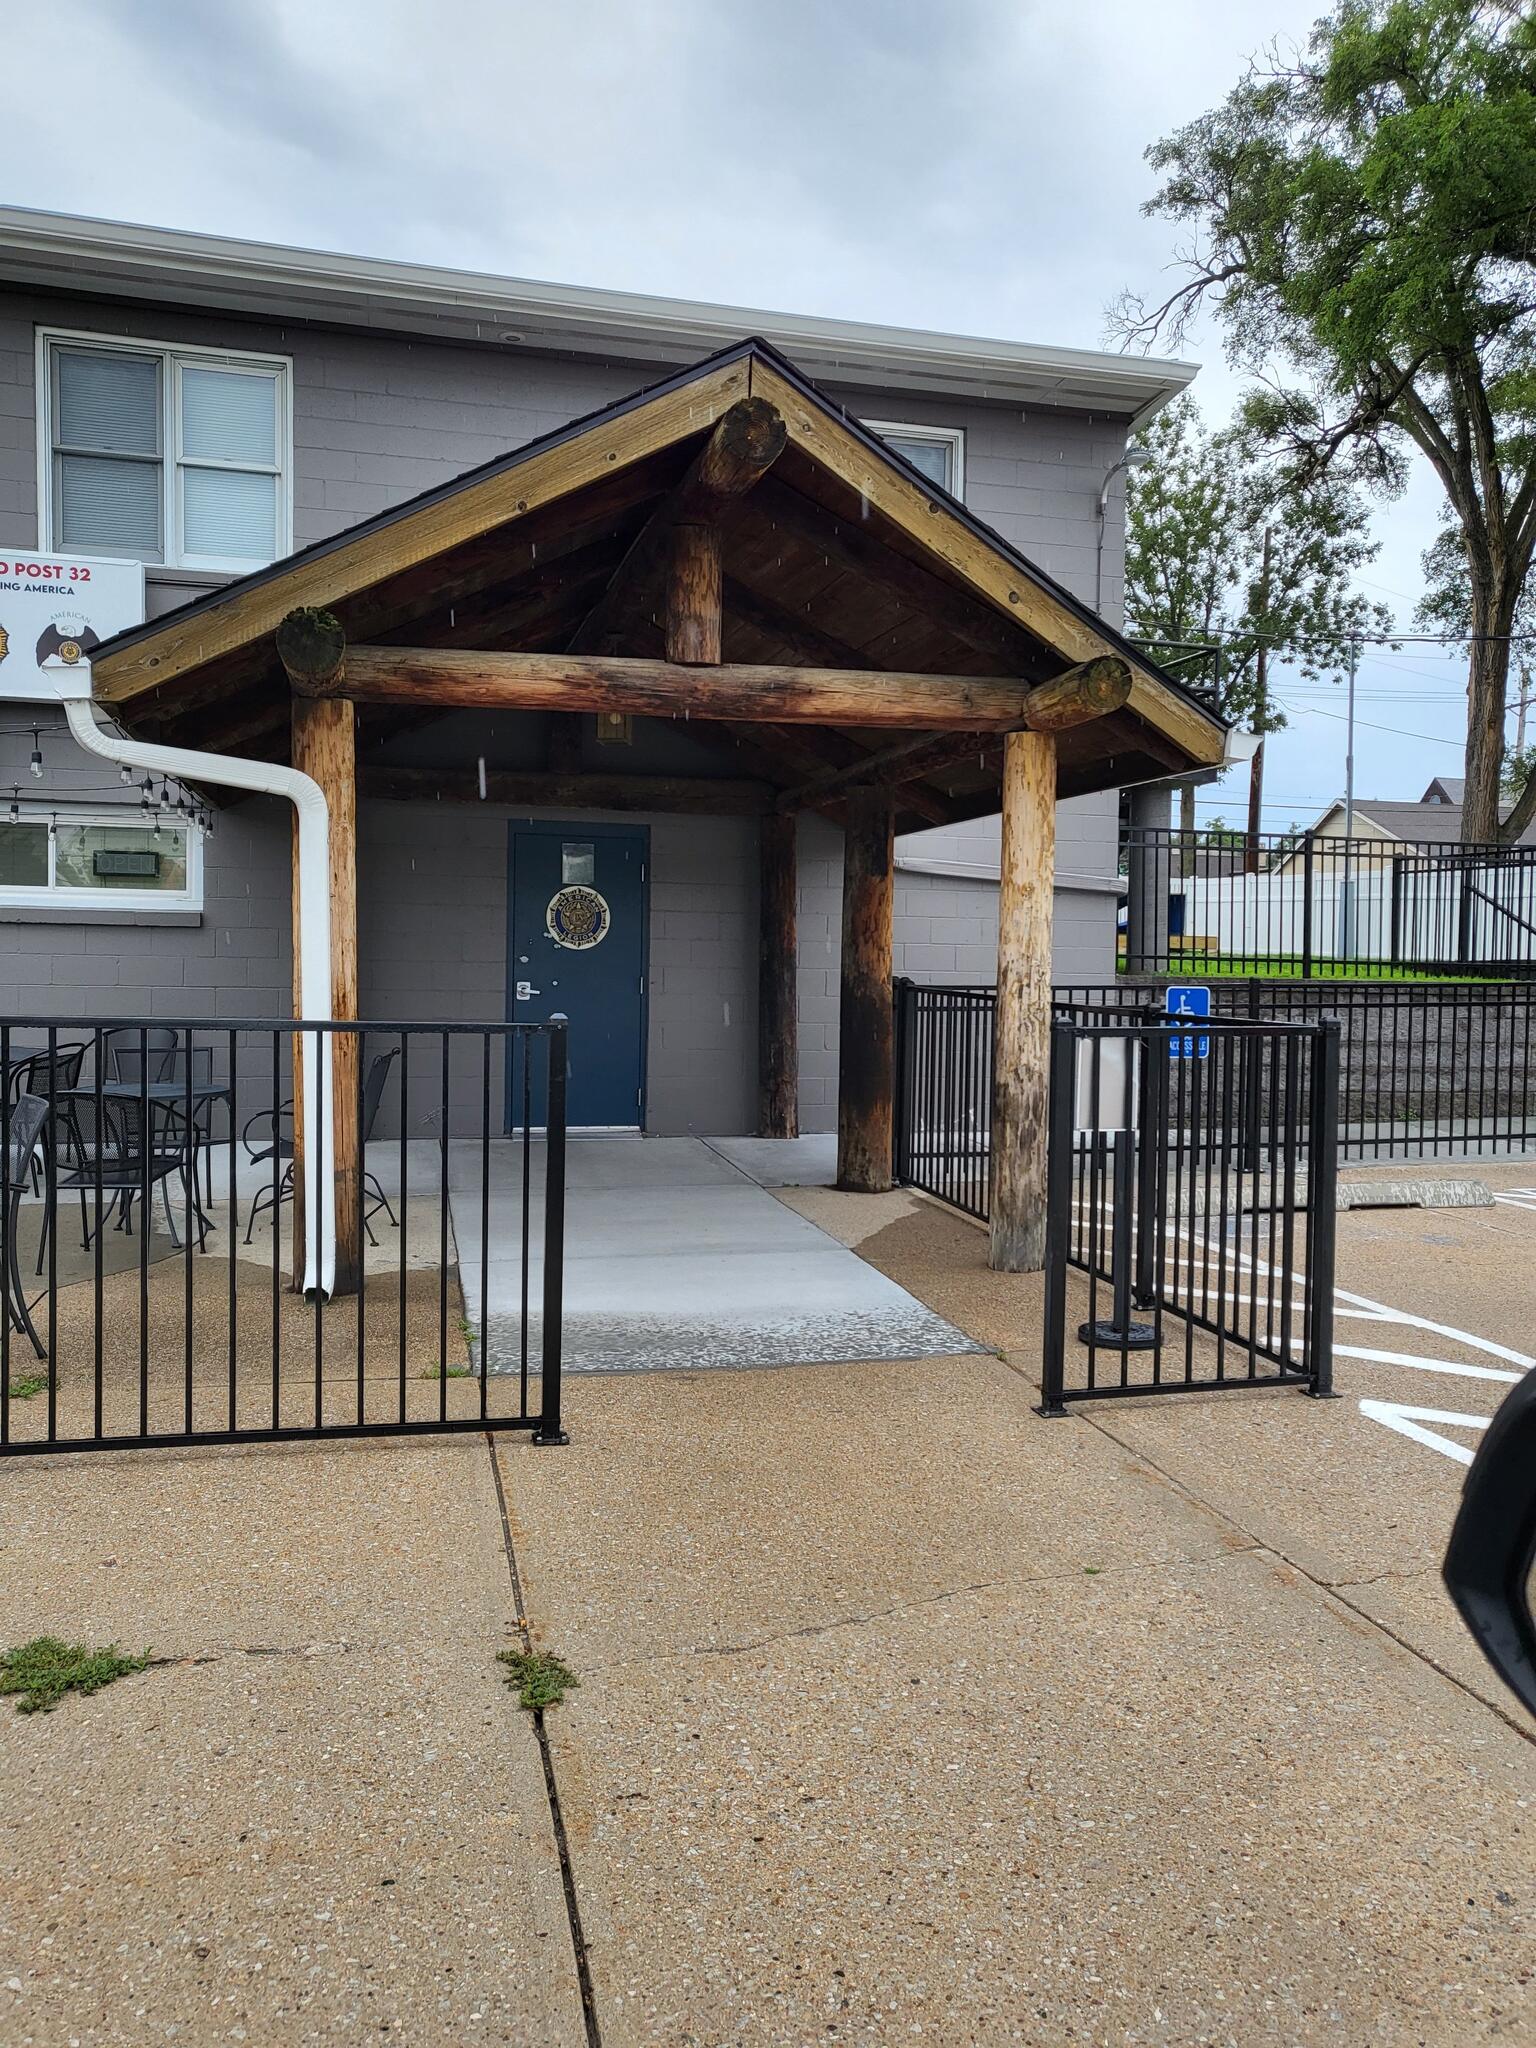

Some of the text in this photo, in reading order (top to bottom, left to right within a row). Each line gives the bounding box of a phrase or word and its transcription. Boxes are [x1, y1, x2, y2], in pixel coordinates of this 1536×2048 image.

[15, 562, 63, 579] POST
[69, 567, 91, 582] 32
[24, 583, 75, 595] AMERICA
[50, 611, 92, 623] AMERICAN
[100, 855, 153, 871] OPEN
[558, 895, 600, 913] AMERICAN
[563, 931, 594, 940] LEGION
